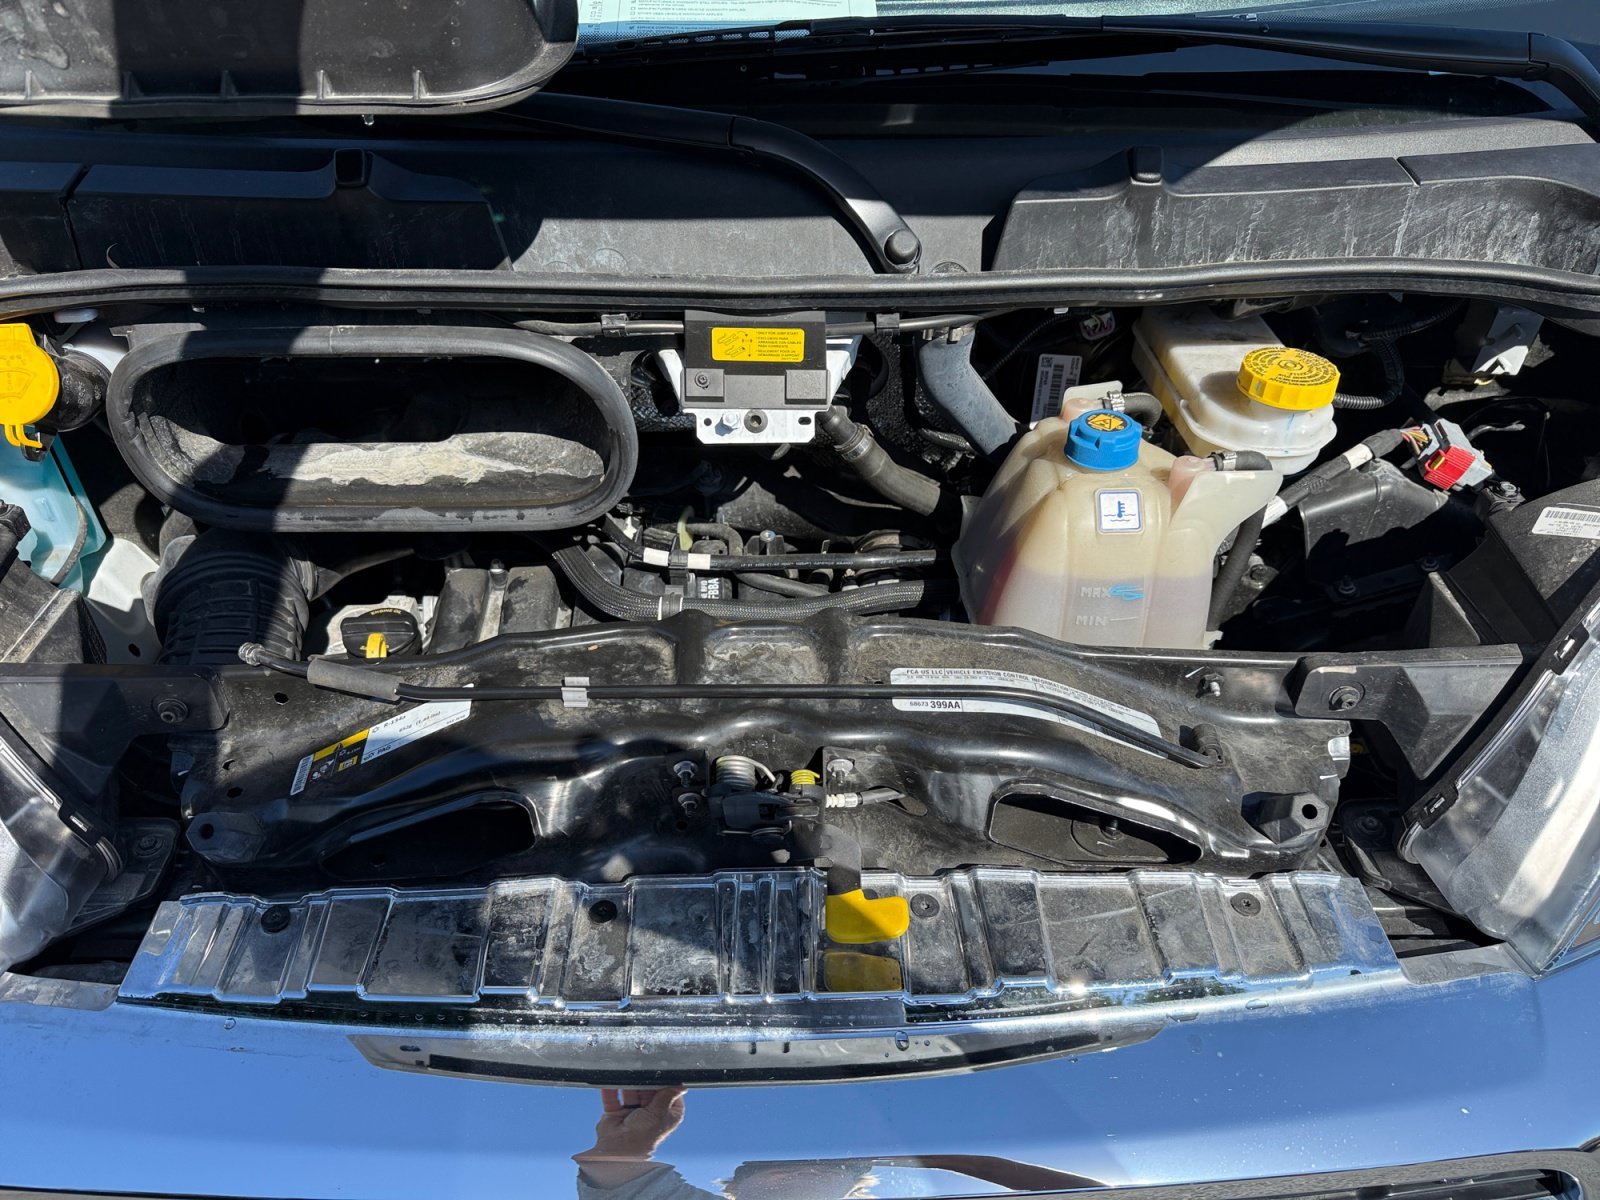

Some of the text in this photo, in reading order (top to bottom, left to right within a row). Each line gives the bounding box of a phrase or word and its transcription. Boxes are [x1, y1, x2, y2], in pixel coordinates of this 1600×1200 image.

[370, 608, 393, 616] ENGINE
[1075, 615, 1107, 626] MIN
[972, 669, 1001, 677] EMISSION
[1003, 672, 1029, 681] CONTROL
[1031, 677, 1069, 691] INFORMATION
[930, 700, 961, 709] 399AA
